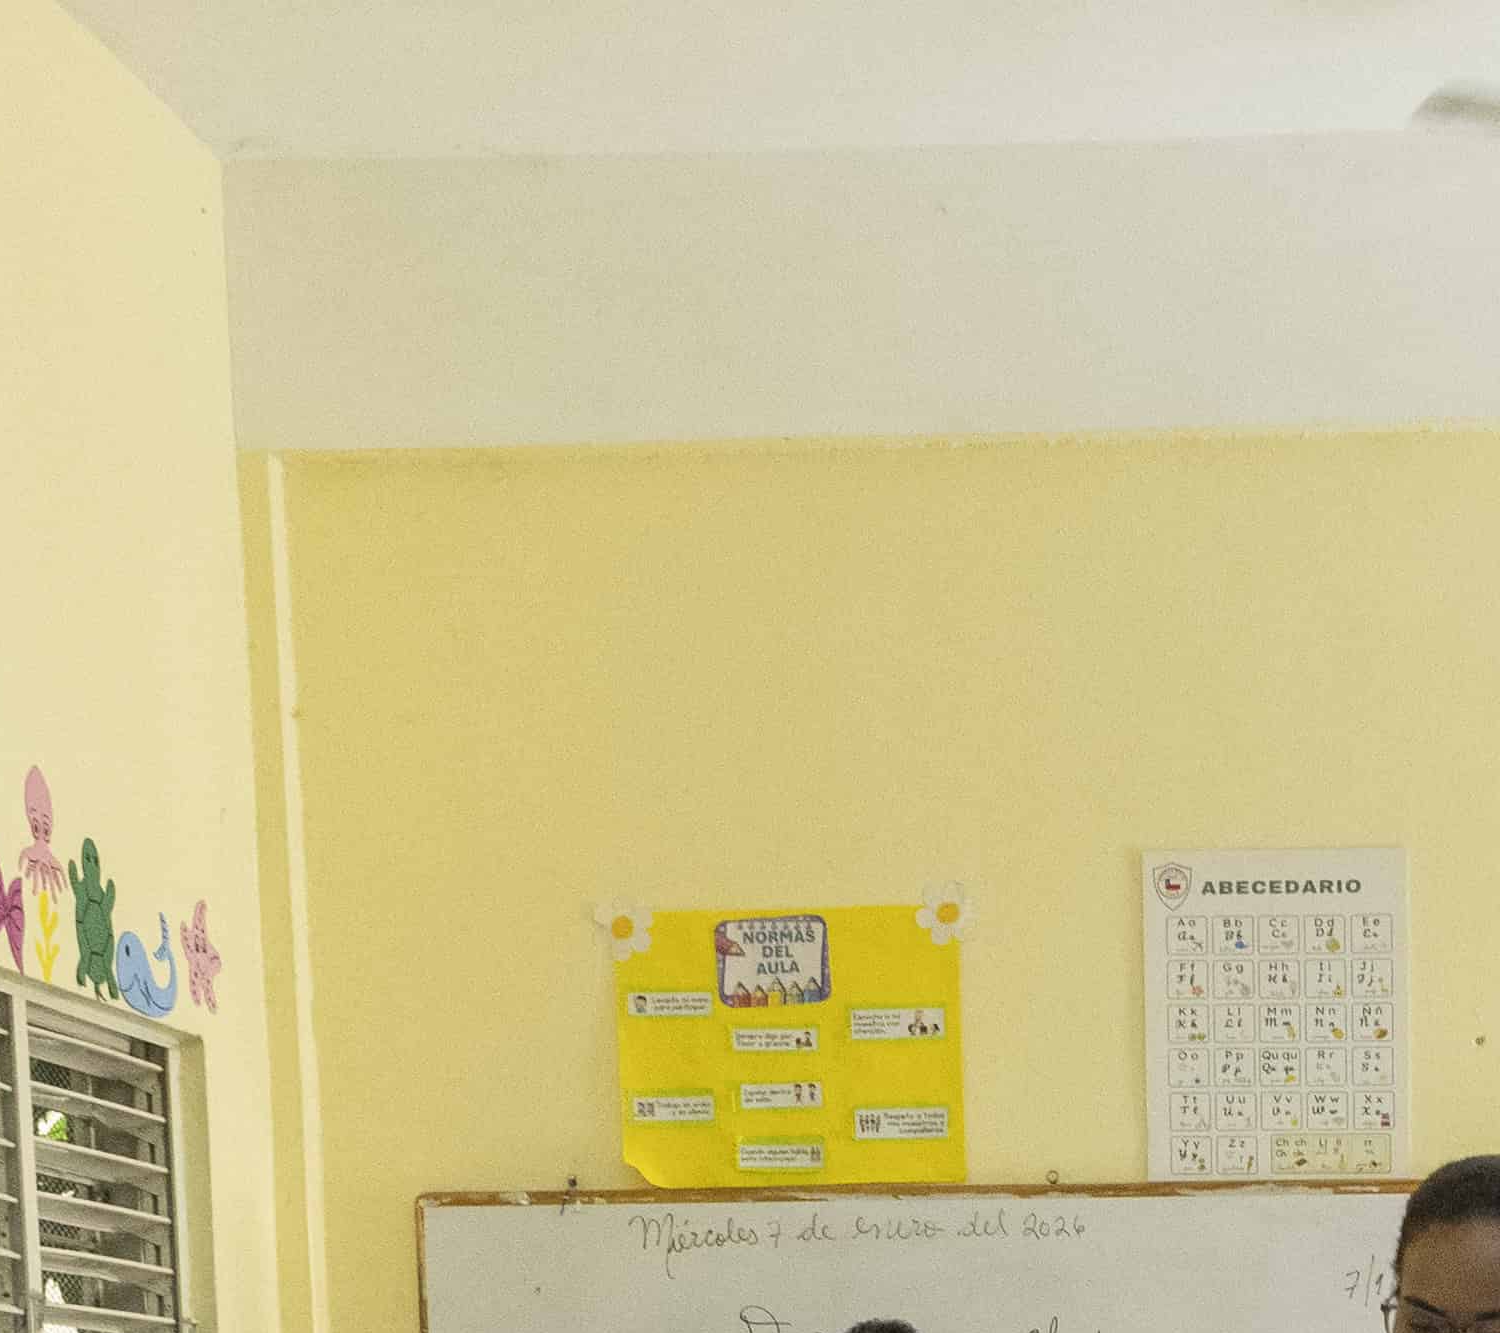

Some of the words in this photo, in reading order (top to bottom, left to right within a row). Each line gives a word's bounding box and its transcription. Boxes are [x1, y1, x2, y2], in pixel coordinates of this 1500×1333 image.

[1201, 879, 1361, 895] ABECEDARIO
[743, 929, 816, 944] NORMAS
[762, 945, 794, 958] DEL
[757, 960, 800, 975] AULA
[628, 1212, 761, 1280] Miércoles
[769, 1220, 781, 1249] 7
[796, 1212, 837, 1241] de
[957, 1208, 1006, 1240] del
[1022, 1213, 1087, 1240] 2026
